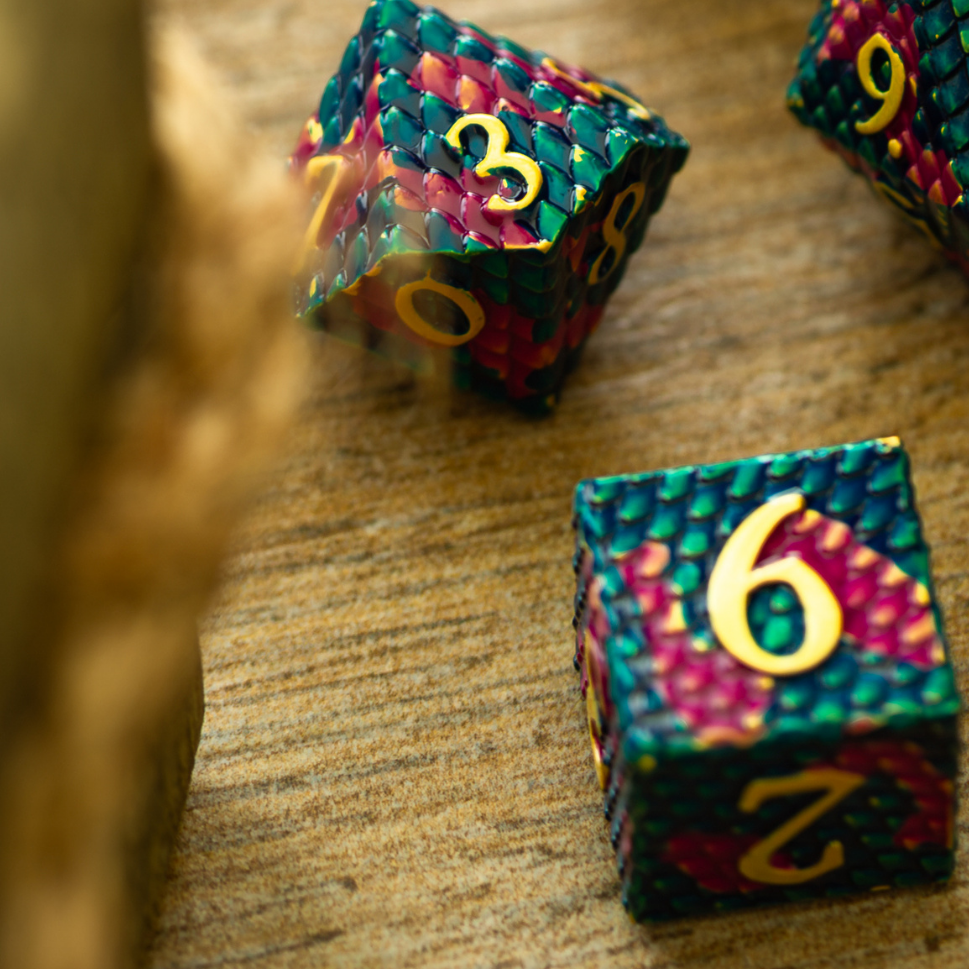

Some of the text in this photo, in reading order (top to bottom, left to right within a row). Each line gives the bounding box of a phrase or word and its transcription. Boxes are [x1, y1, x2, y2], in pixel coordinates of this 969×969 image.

[445, 113, 543, 210] 3
[588, 182, 645, 285] 8
[394, 277, 486, 346] 0
[707, 490, 843, 675] 6
[738, 768, 867, 884] 2
